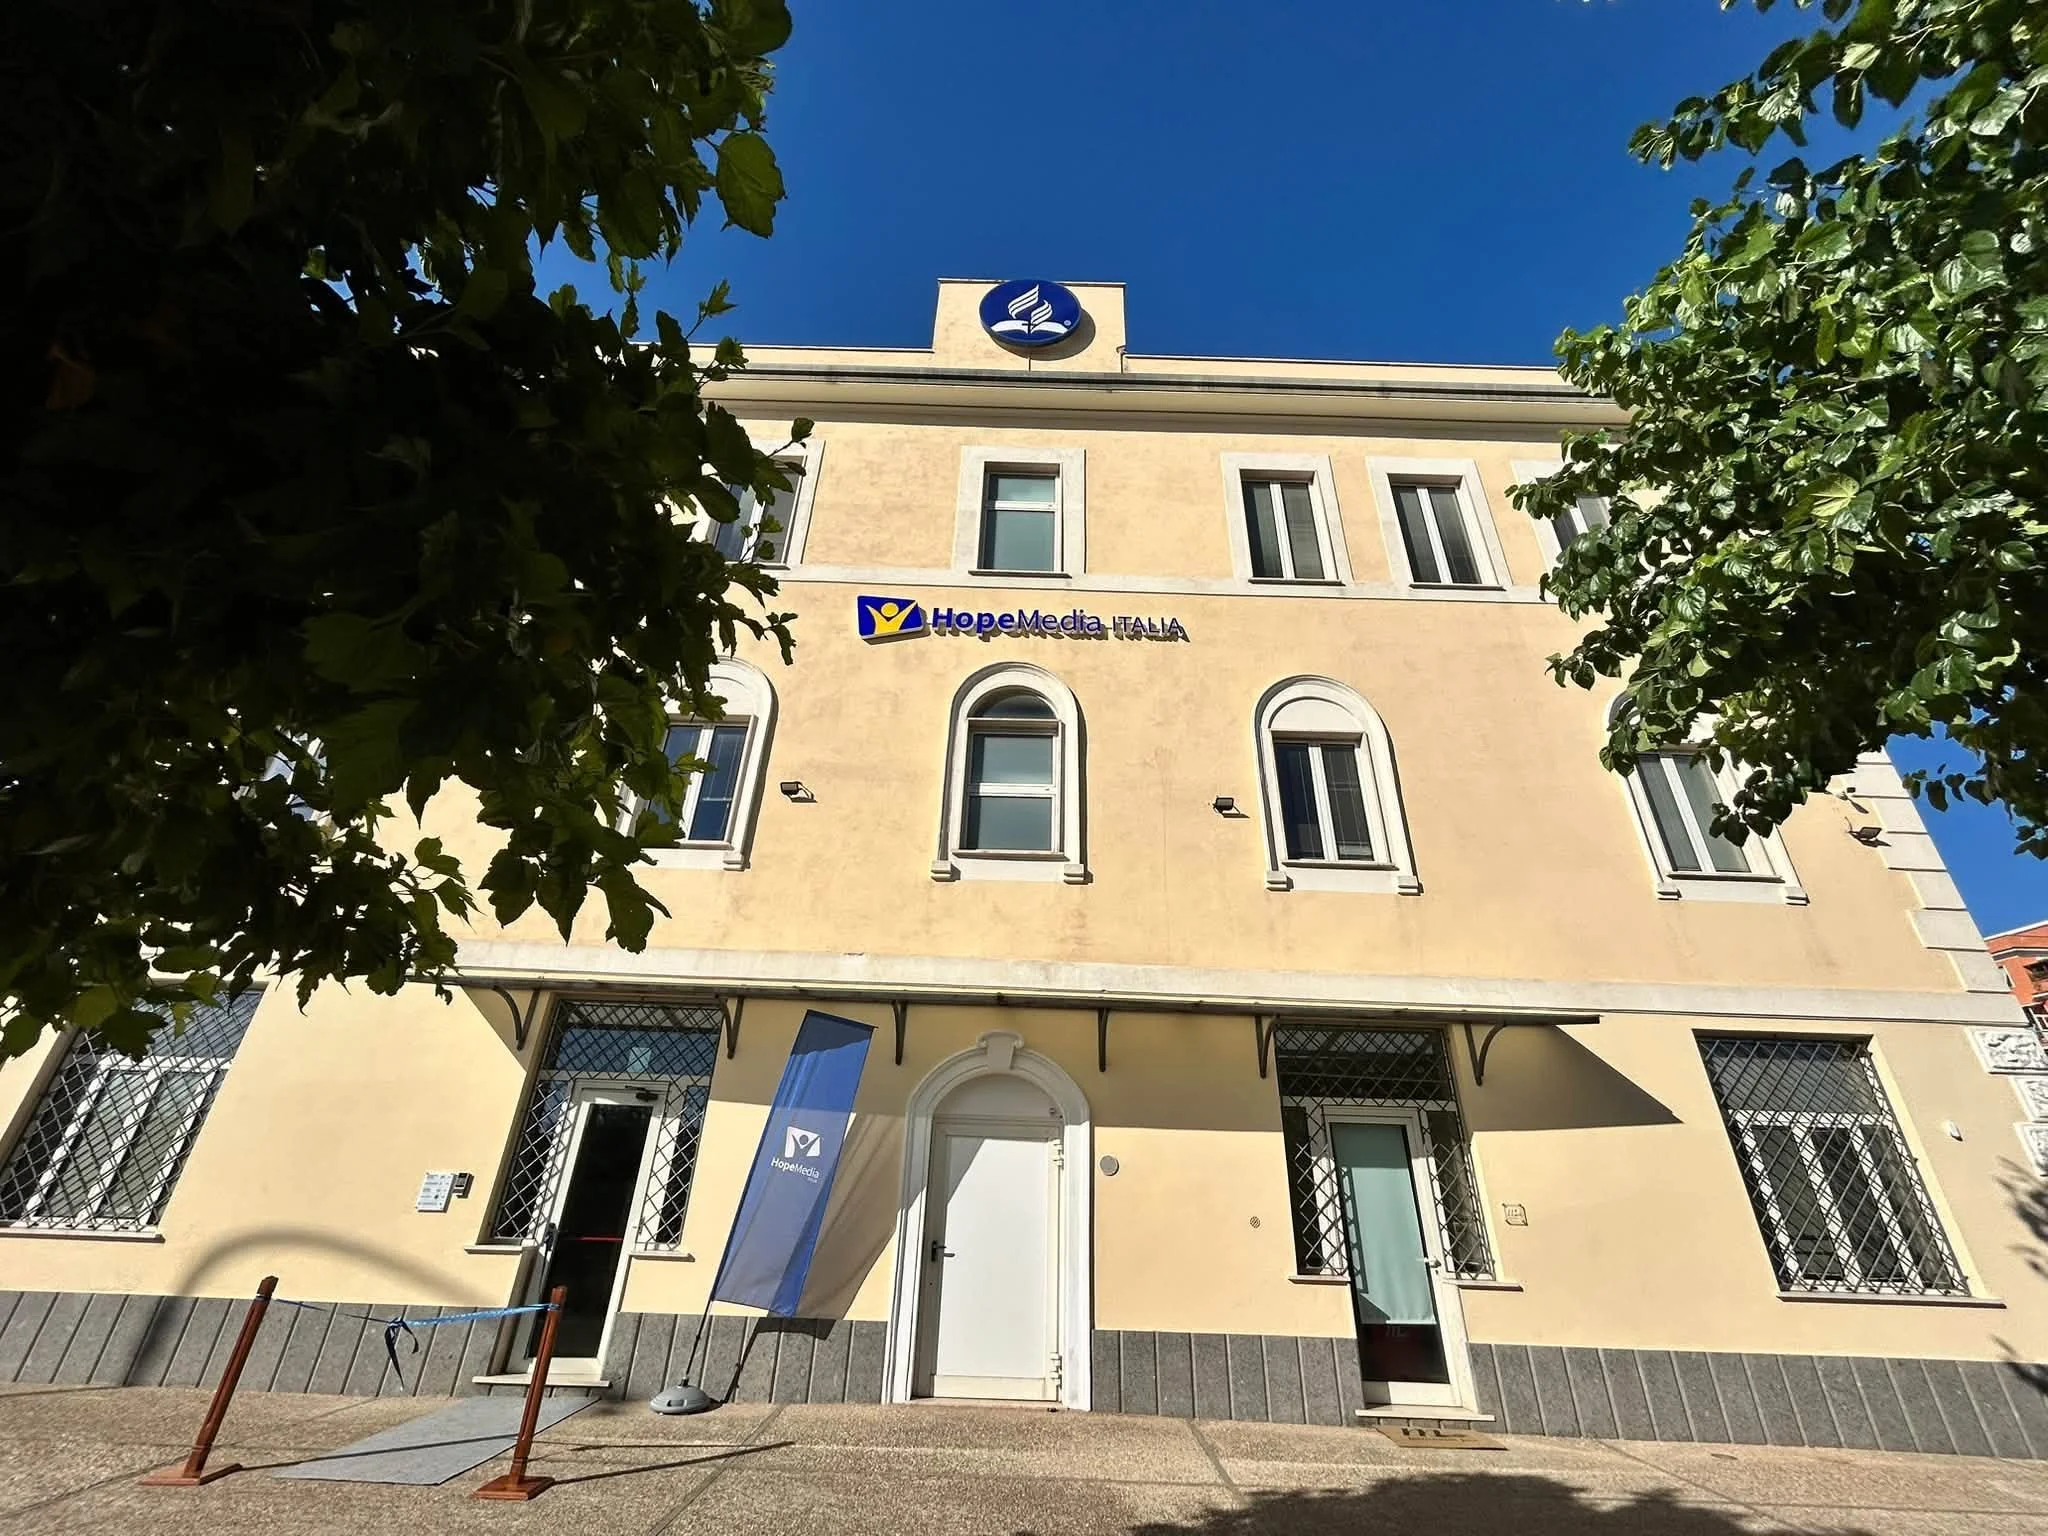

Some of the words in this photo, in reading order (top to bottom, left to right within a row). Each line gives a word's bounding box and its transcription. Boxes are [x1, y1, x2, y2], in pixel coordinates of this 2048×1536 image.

[932, 607, 1101, 634] HopeMedia
[1112, 615, 1184, 633] ITALIA
[770, 1157, 820, 1179] HopeMedia
